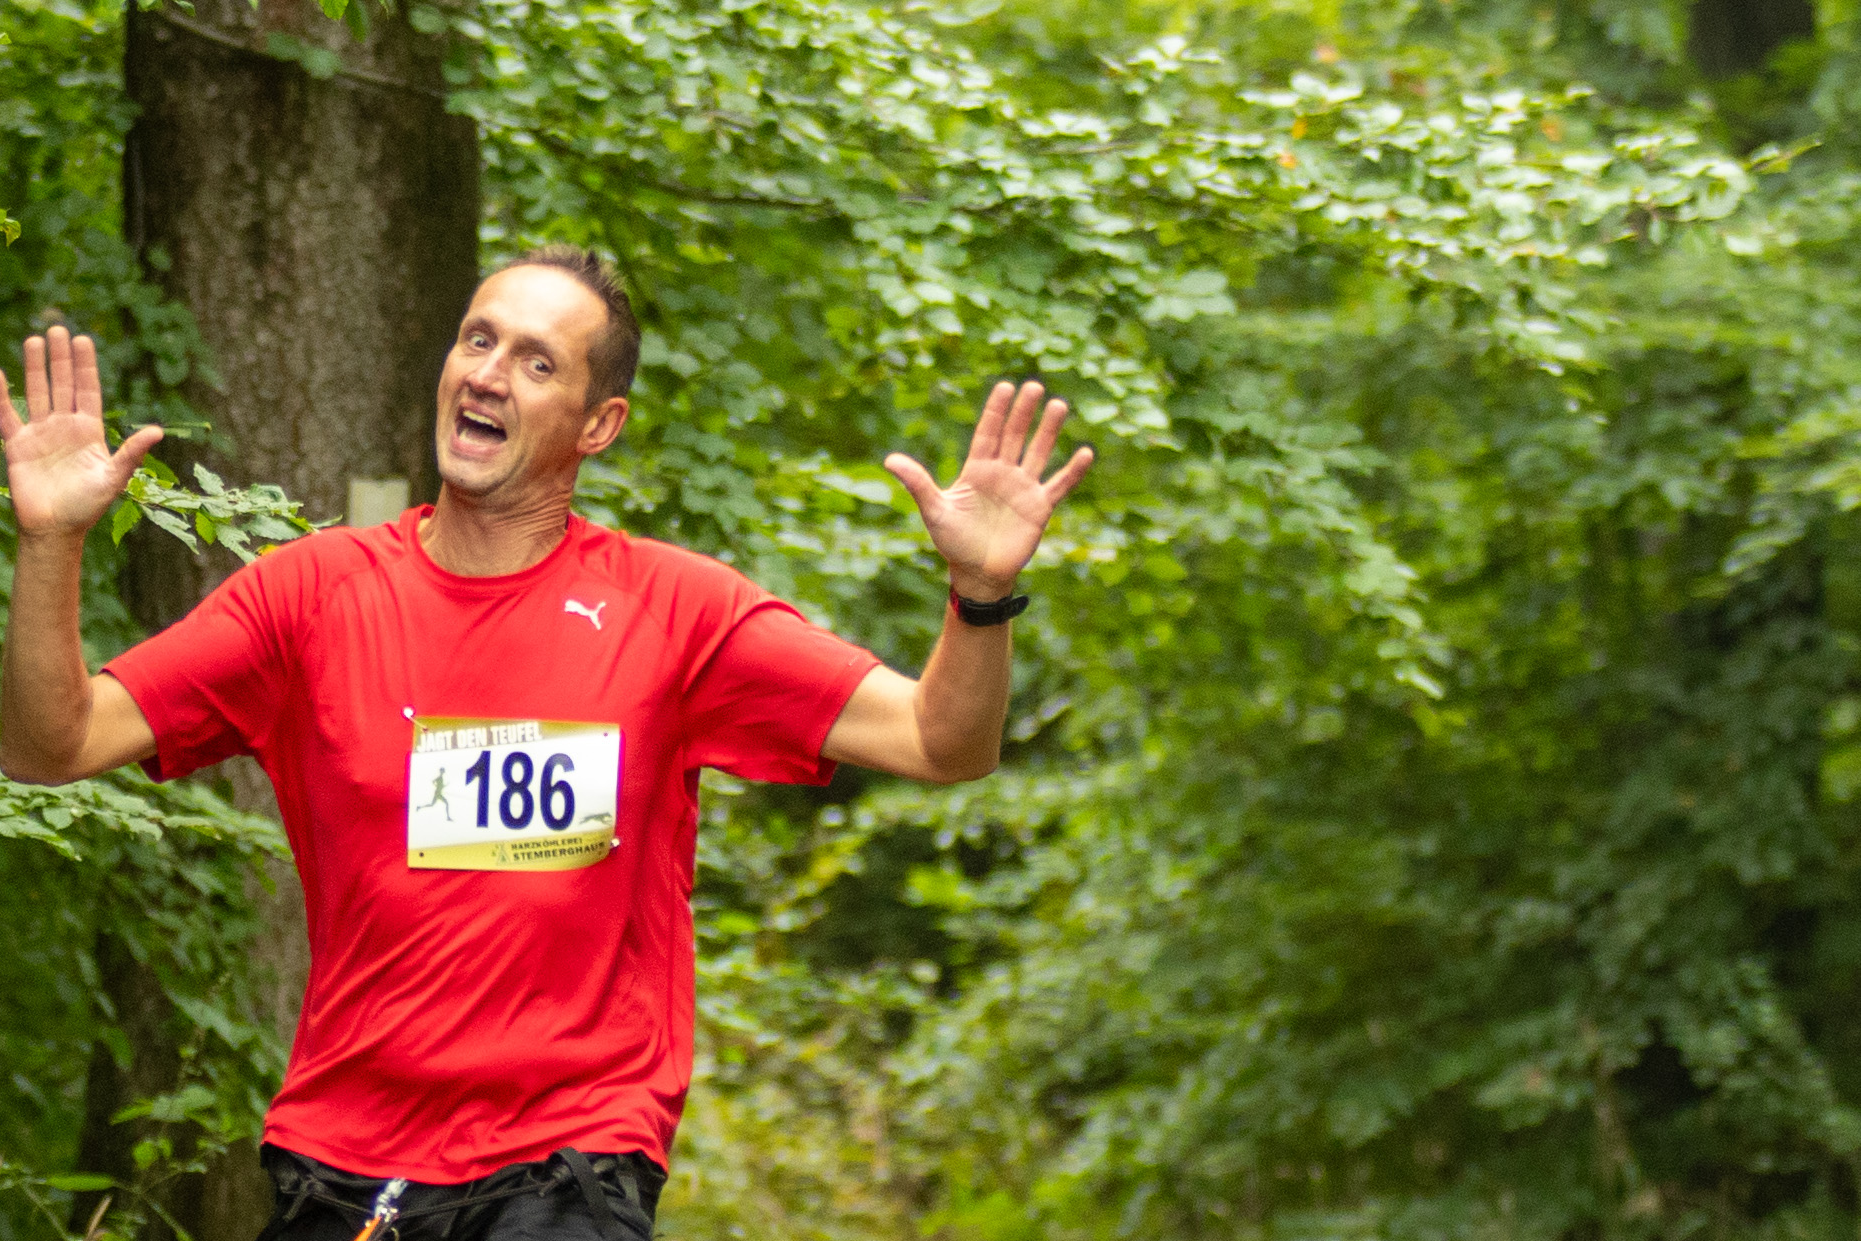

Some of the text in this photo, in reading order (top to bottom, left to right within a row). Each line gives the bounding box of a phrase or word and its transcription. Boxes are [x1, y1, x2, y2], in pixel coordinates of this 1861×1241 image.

[417, 722, 542, 753] JAGT DEN TEUFEL
[465, 750, 576, 831] 186
